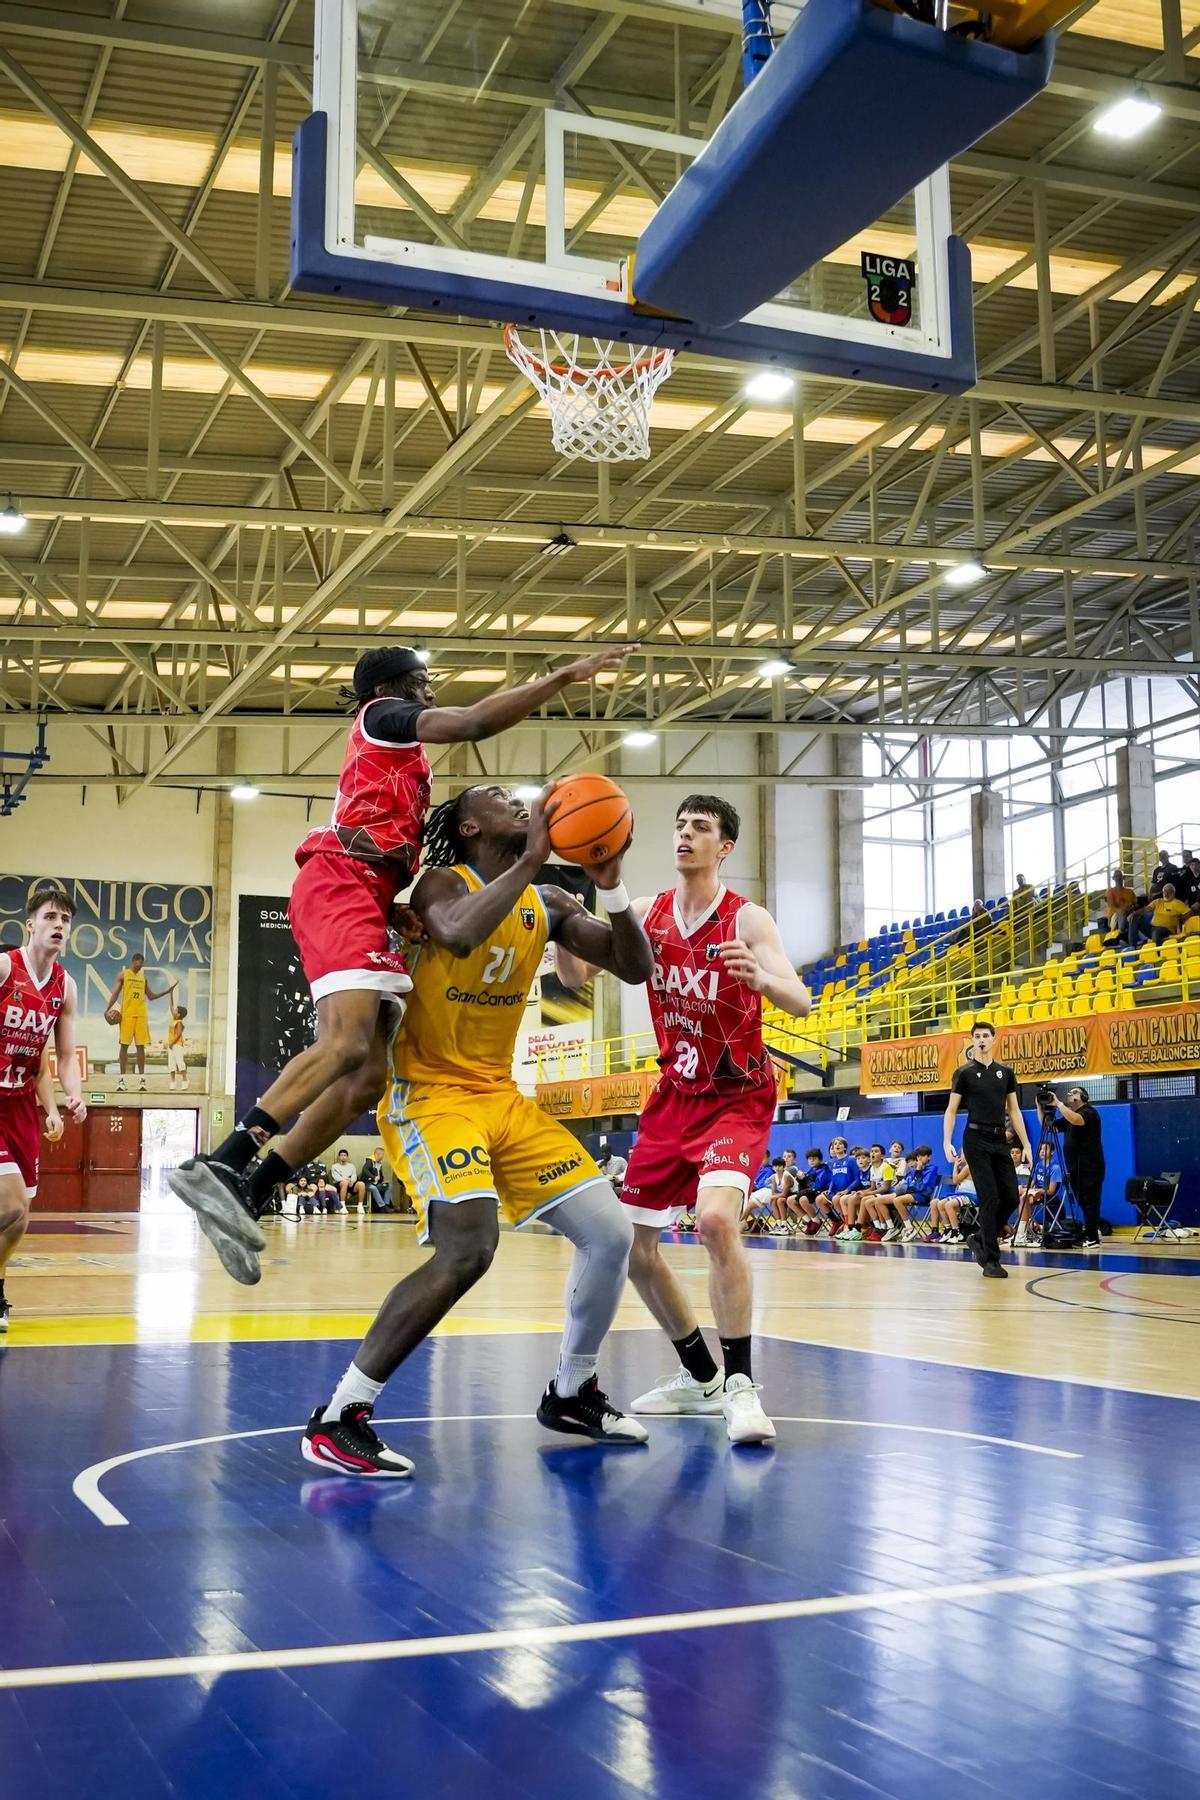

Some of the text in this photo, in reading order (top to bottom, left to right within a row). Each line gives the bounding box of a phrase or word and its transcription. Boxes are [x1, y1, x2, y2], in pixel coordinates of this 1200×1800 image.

[865, 256, 910, 280] LIGA
[871, 285, 908, 307] 2 2
[481, 945, 515, 984] 21
[651, 962, 719, 1001] BAXI
[1001, 1026, 1087, 1060] GRAN CANARIA
[1110, 1019, 1148, 1050] GRAN
[673, 1040, 699, 1080] 20
[1023, 1061, 1034, 1074] DE
[1035, 1055, 1087, 1073] BALONCESTO
[1111, 1050, 1136, 1065] CLUB
[1138, 1050, 1149, 1063] DE
[538, 1159, 580, 1185] SUMA
